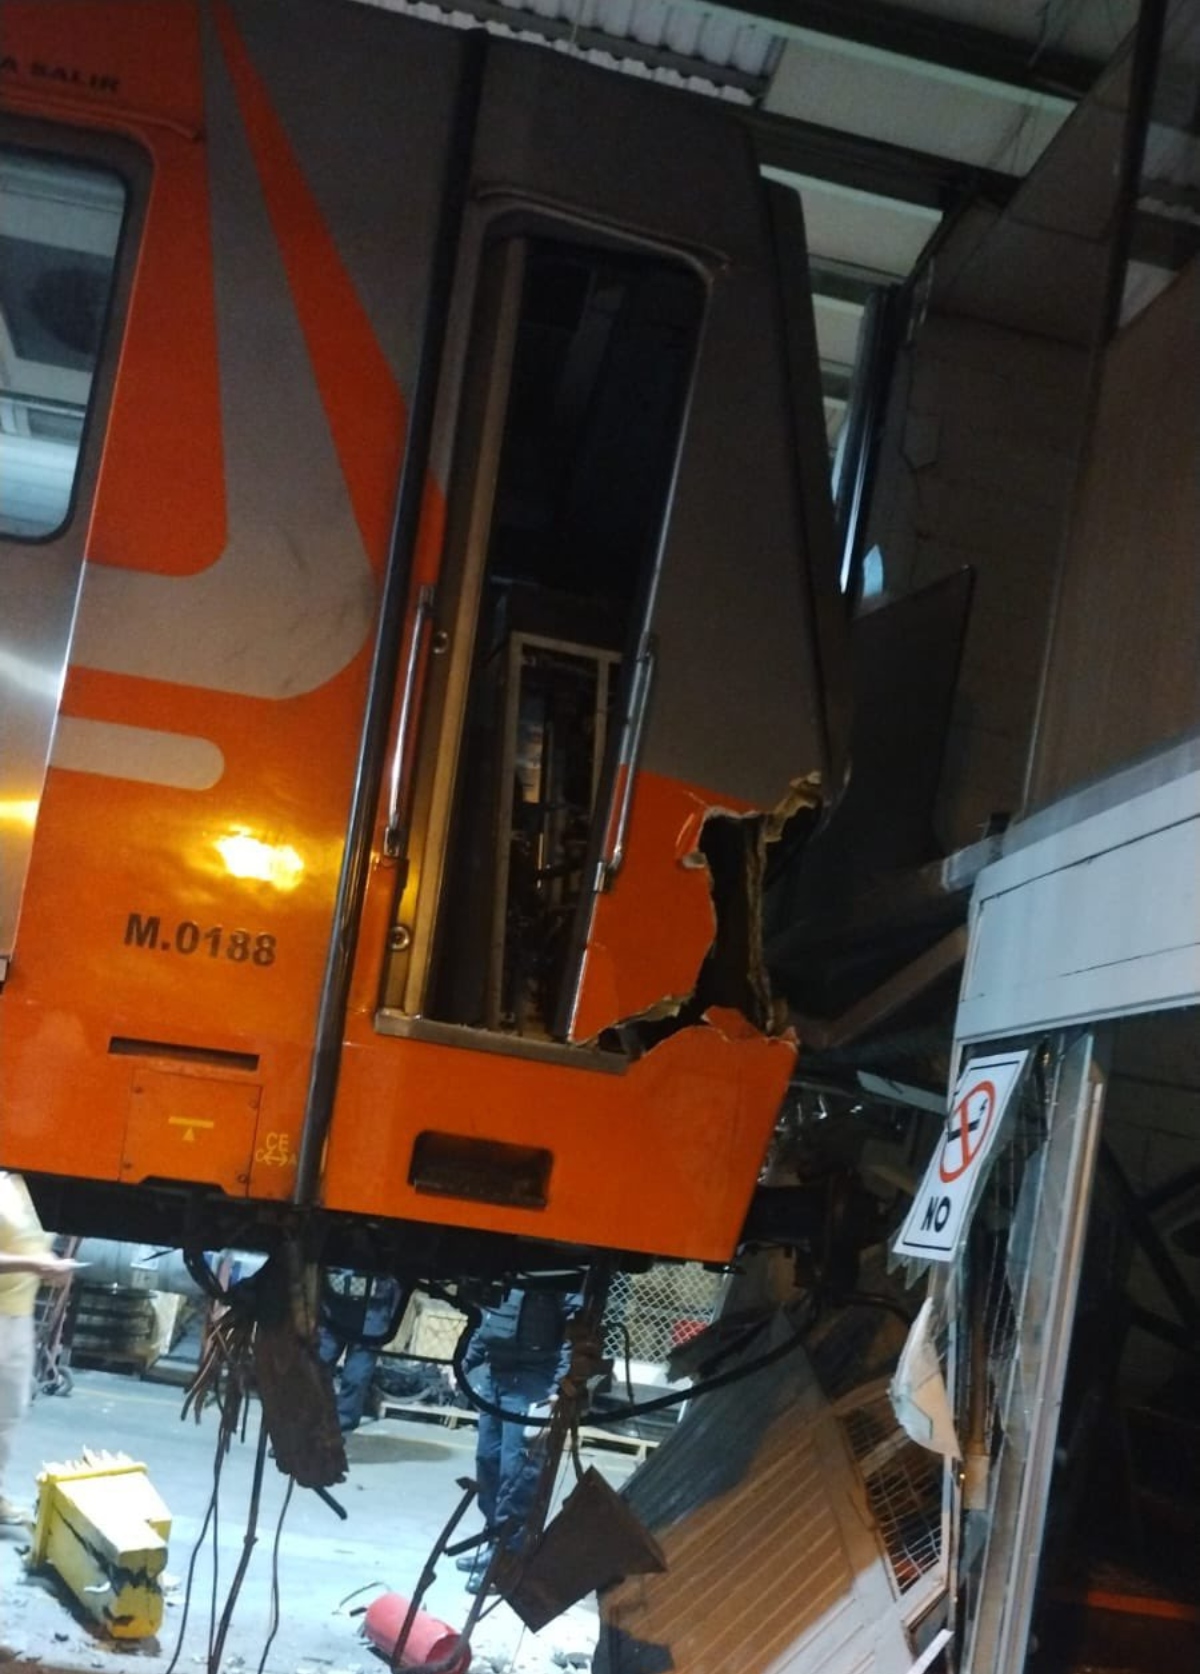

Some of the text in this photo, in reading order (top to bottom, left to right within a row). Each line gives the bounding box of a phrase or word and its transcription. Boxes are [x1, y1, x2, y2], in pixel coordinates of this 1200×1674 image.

[123, 912, 277, 967] M.0188
[265, 1131, 289, 1151] CE
[920, 1195, 951, 1233] NO
